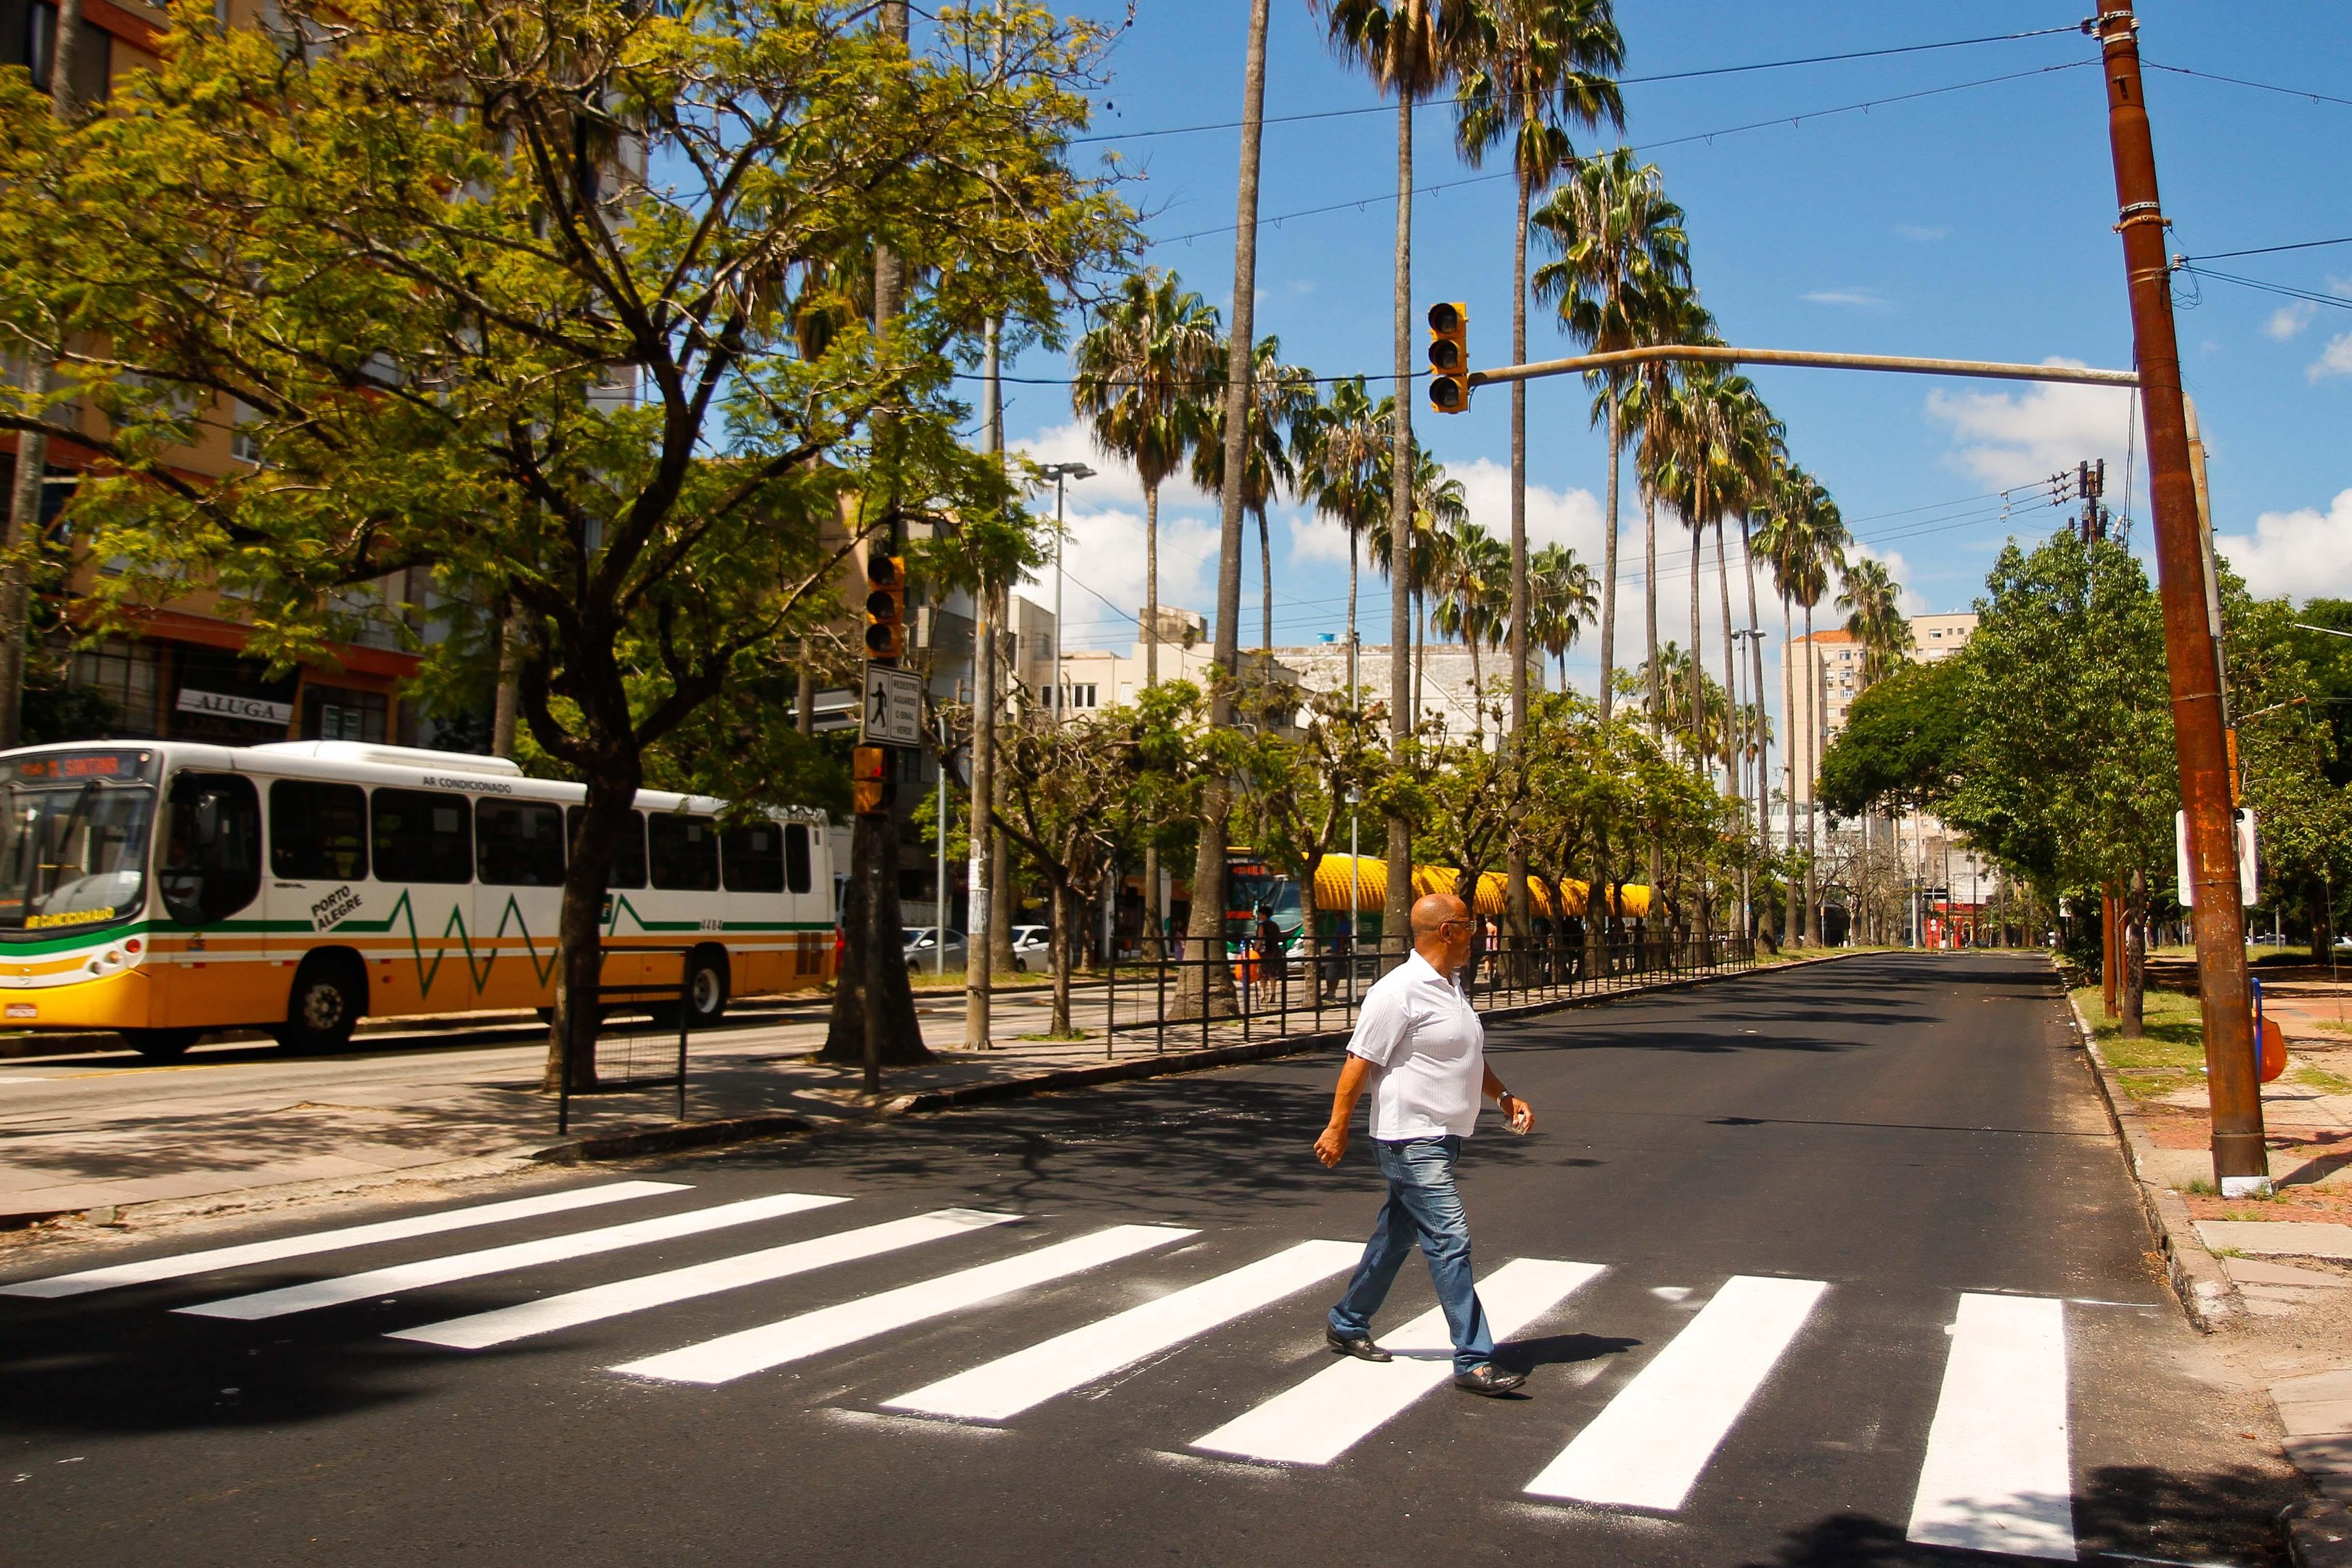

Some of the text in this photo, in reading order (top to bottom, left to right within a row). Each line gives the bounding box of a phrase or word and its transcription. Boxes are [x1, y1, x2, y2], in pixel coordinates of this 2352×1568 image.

[893, 679, 918, 692] PEDESTRE
[195, 695, 276, 719] ALUGA
[894, 695, 918, 706] AGUARDE
[901, 711, 914, 721] SINAL
[897, 726, 912, 735] VERDE
[423, 776, 512, 793] AR CONDICIONADO
[311, 885, 350, 916] PORTO
[318, 894, 363, 931] ALEGRE
